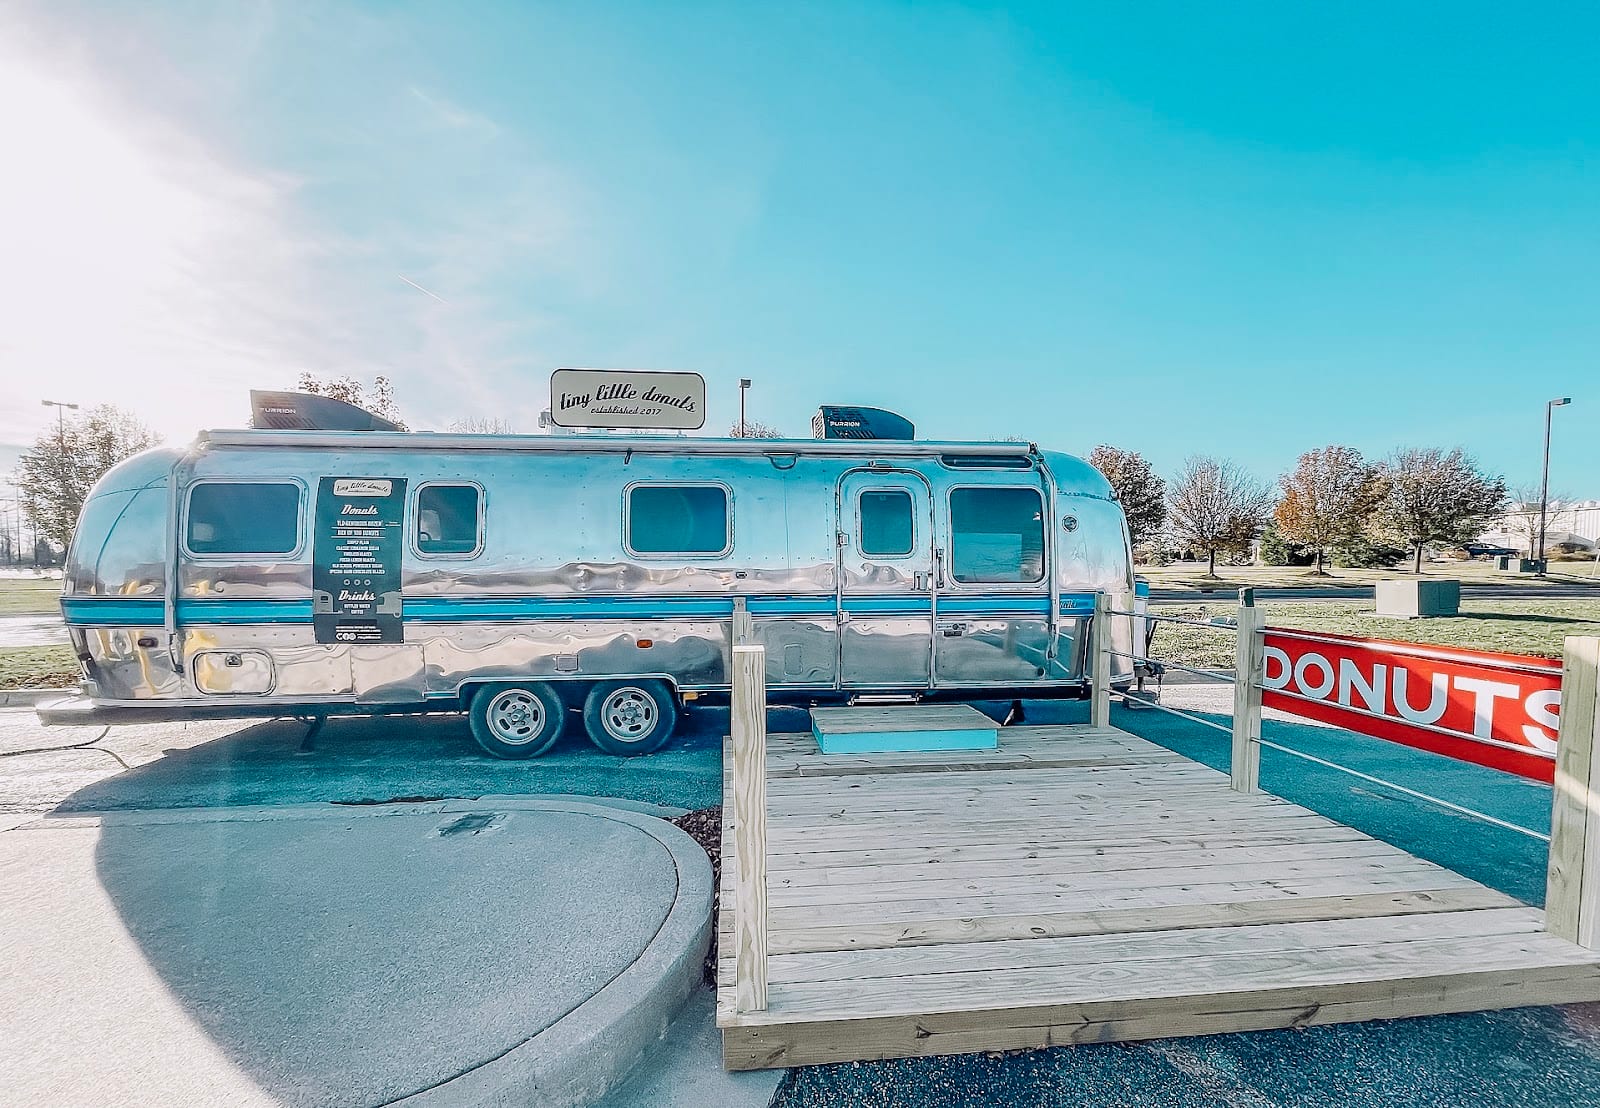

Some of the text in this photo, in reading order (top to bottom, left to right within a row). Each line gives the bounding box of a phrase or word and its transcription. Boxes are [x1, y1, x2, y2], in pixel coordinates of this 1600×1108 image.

[560, 383, 696, 412] tiny little donuts
[590, 405, 638, 415] established
[341, 504, 379, 515] Donuts
[338, 590, 377, 601] Drinks
[1262, 645, 1562, 753] DONUTS
